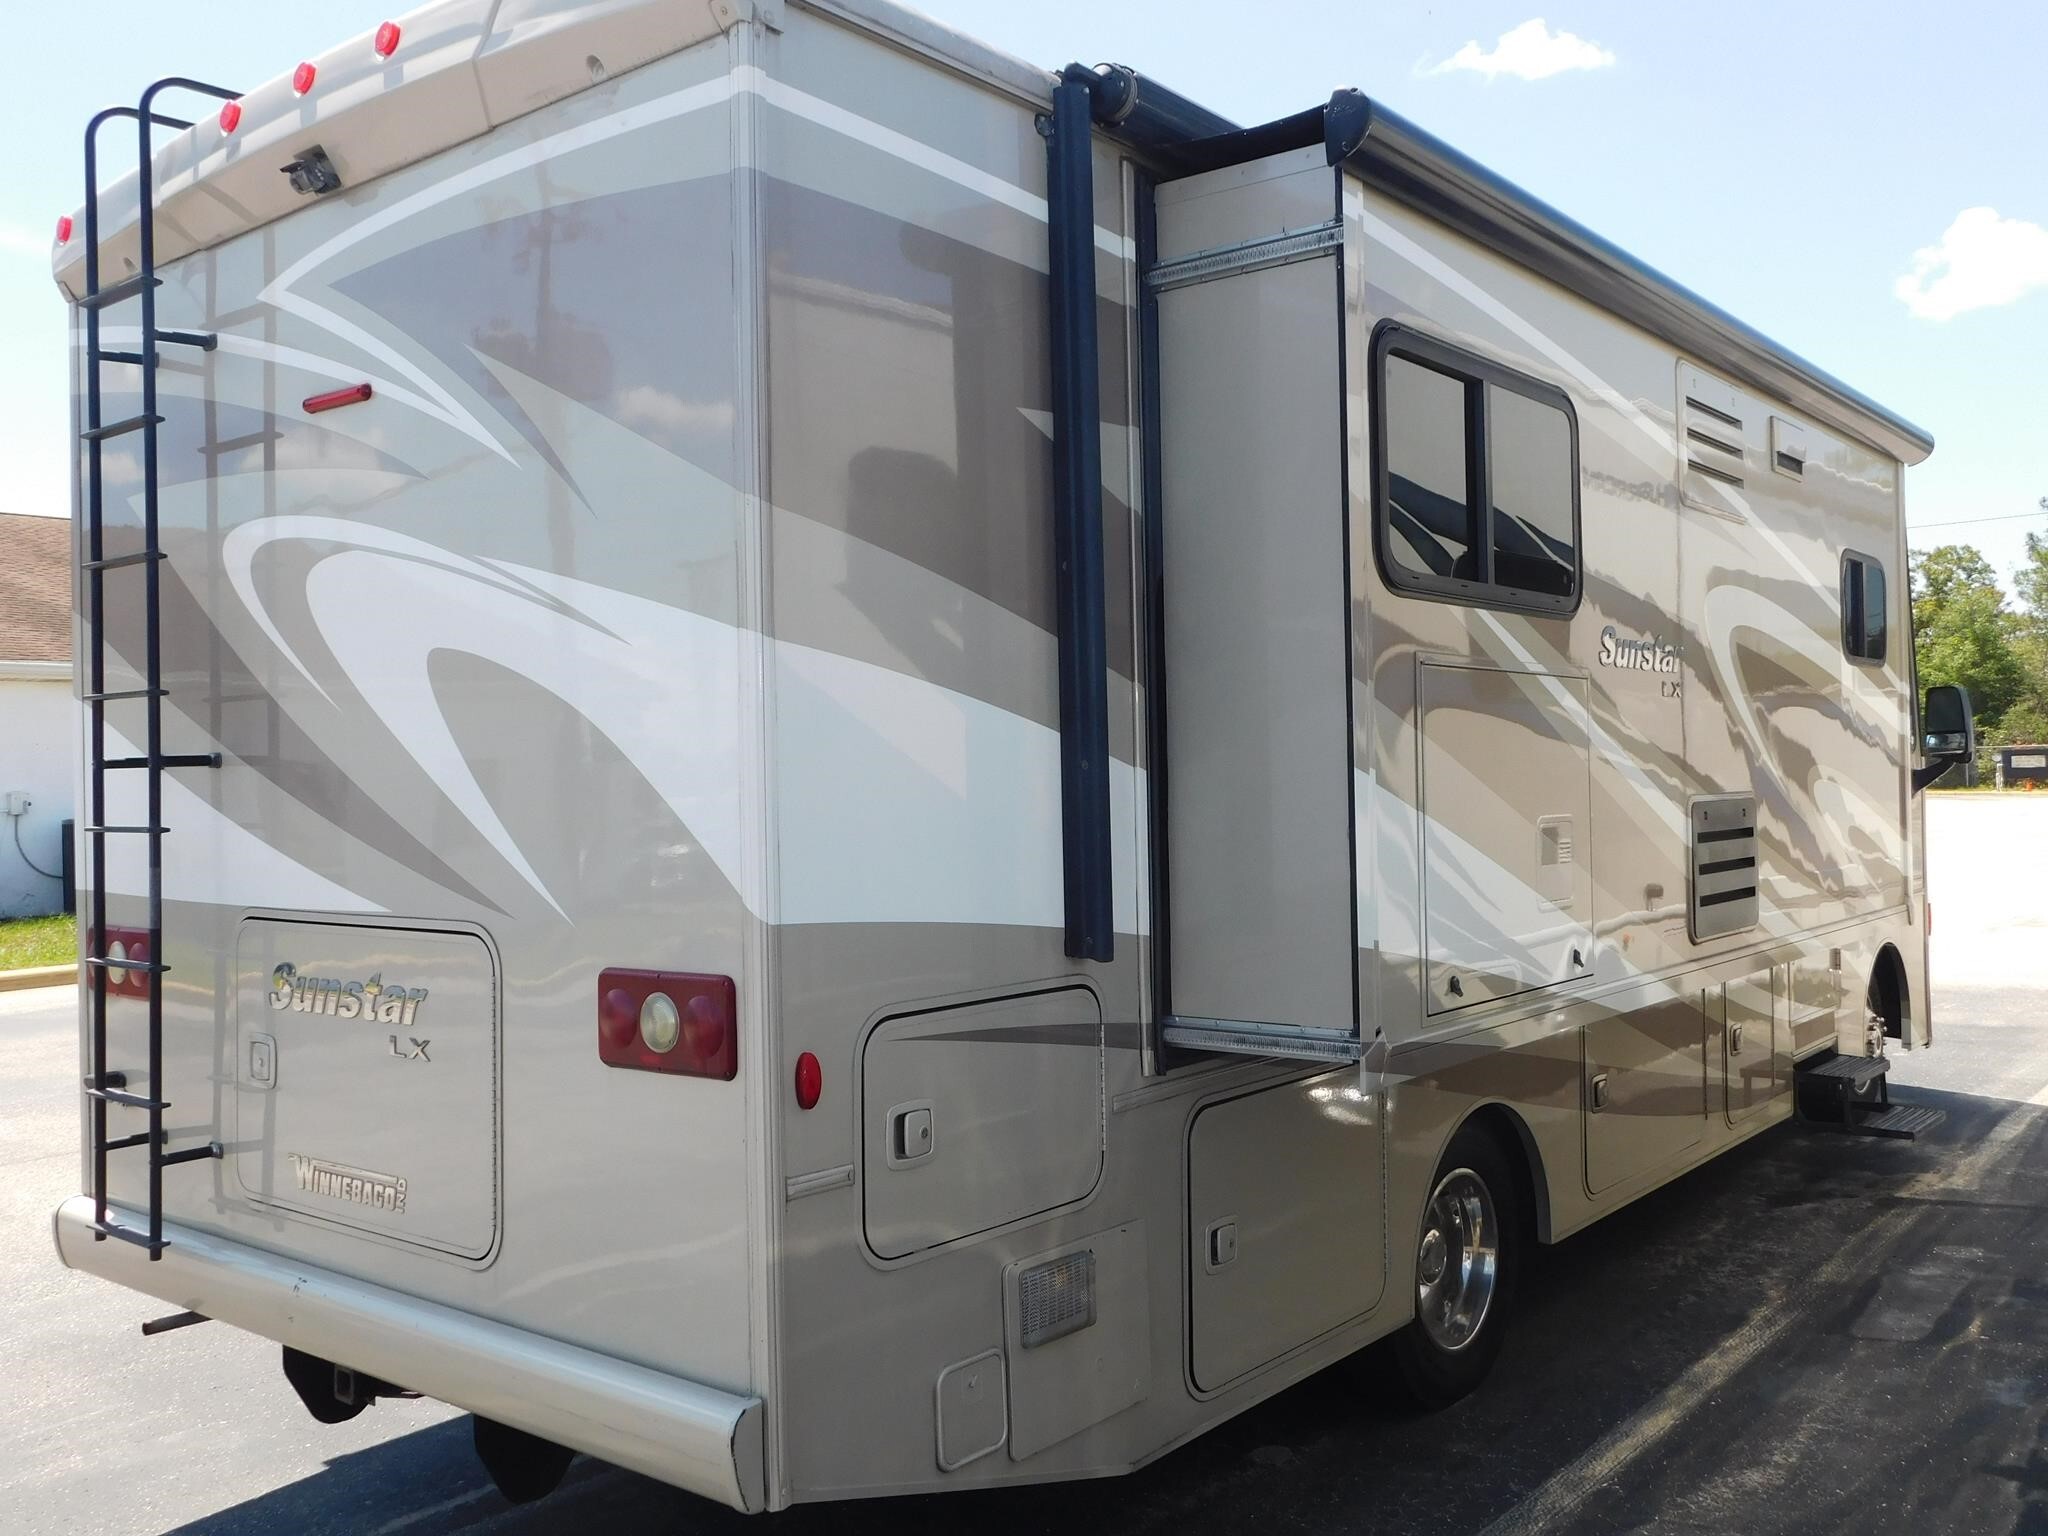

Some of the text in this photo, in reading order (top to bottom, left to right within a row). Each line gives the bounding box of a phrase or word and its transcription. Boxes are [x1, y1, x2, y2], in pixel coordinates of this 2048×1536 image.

[1599, 625, 1684, 673] Sunstar
[1661, 681, 1681, 698] LX
[269, 961, 429, 1026] Sunstar
[389, 1034, 431, 1062] LX
[288, 1152, 397, 1212] WINNEBAGO
